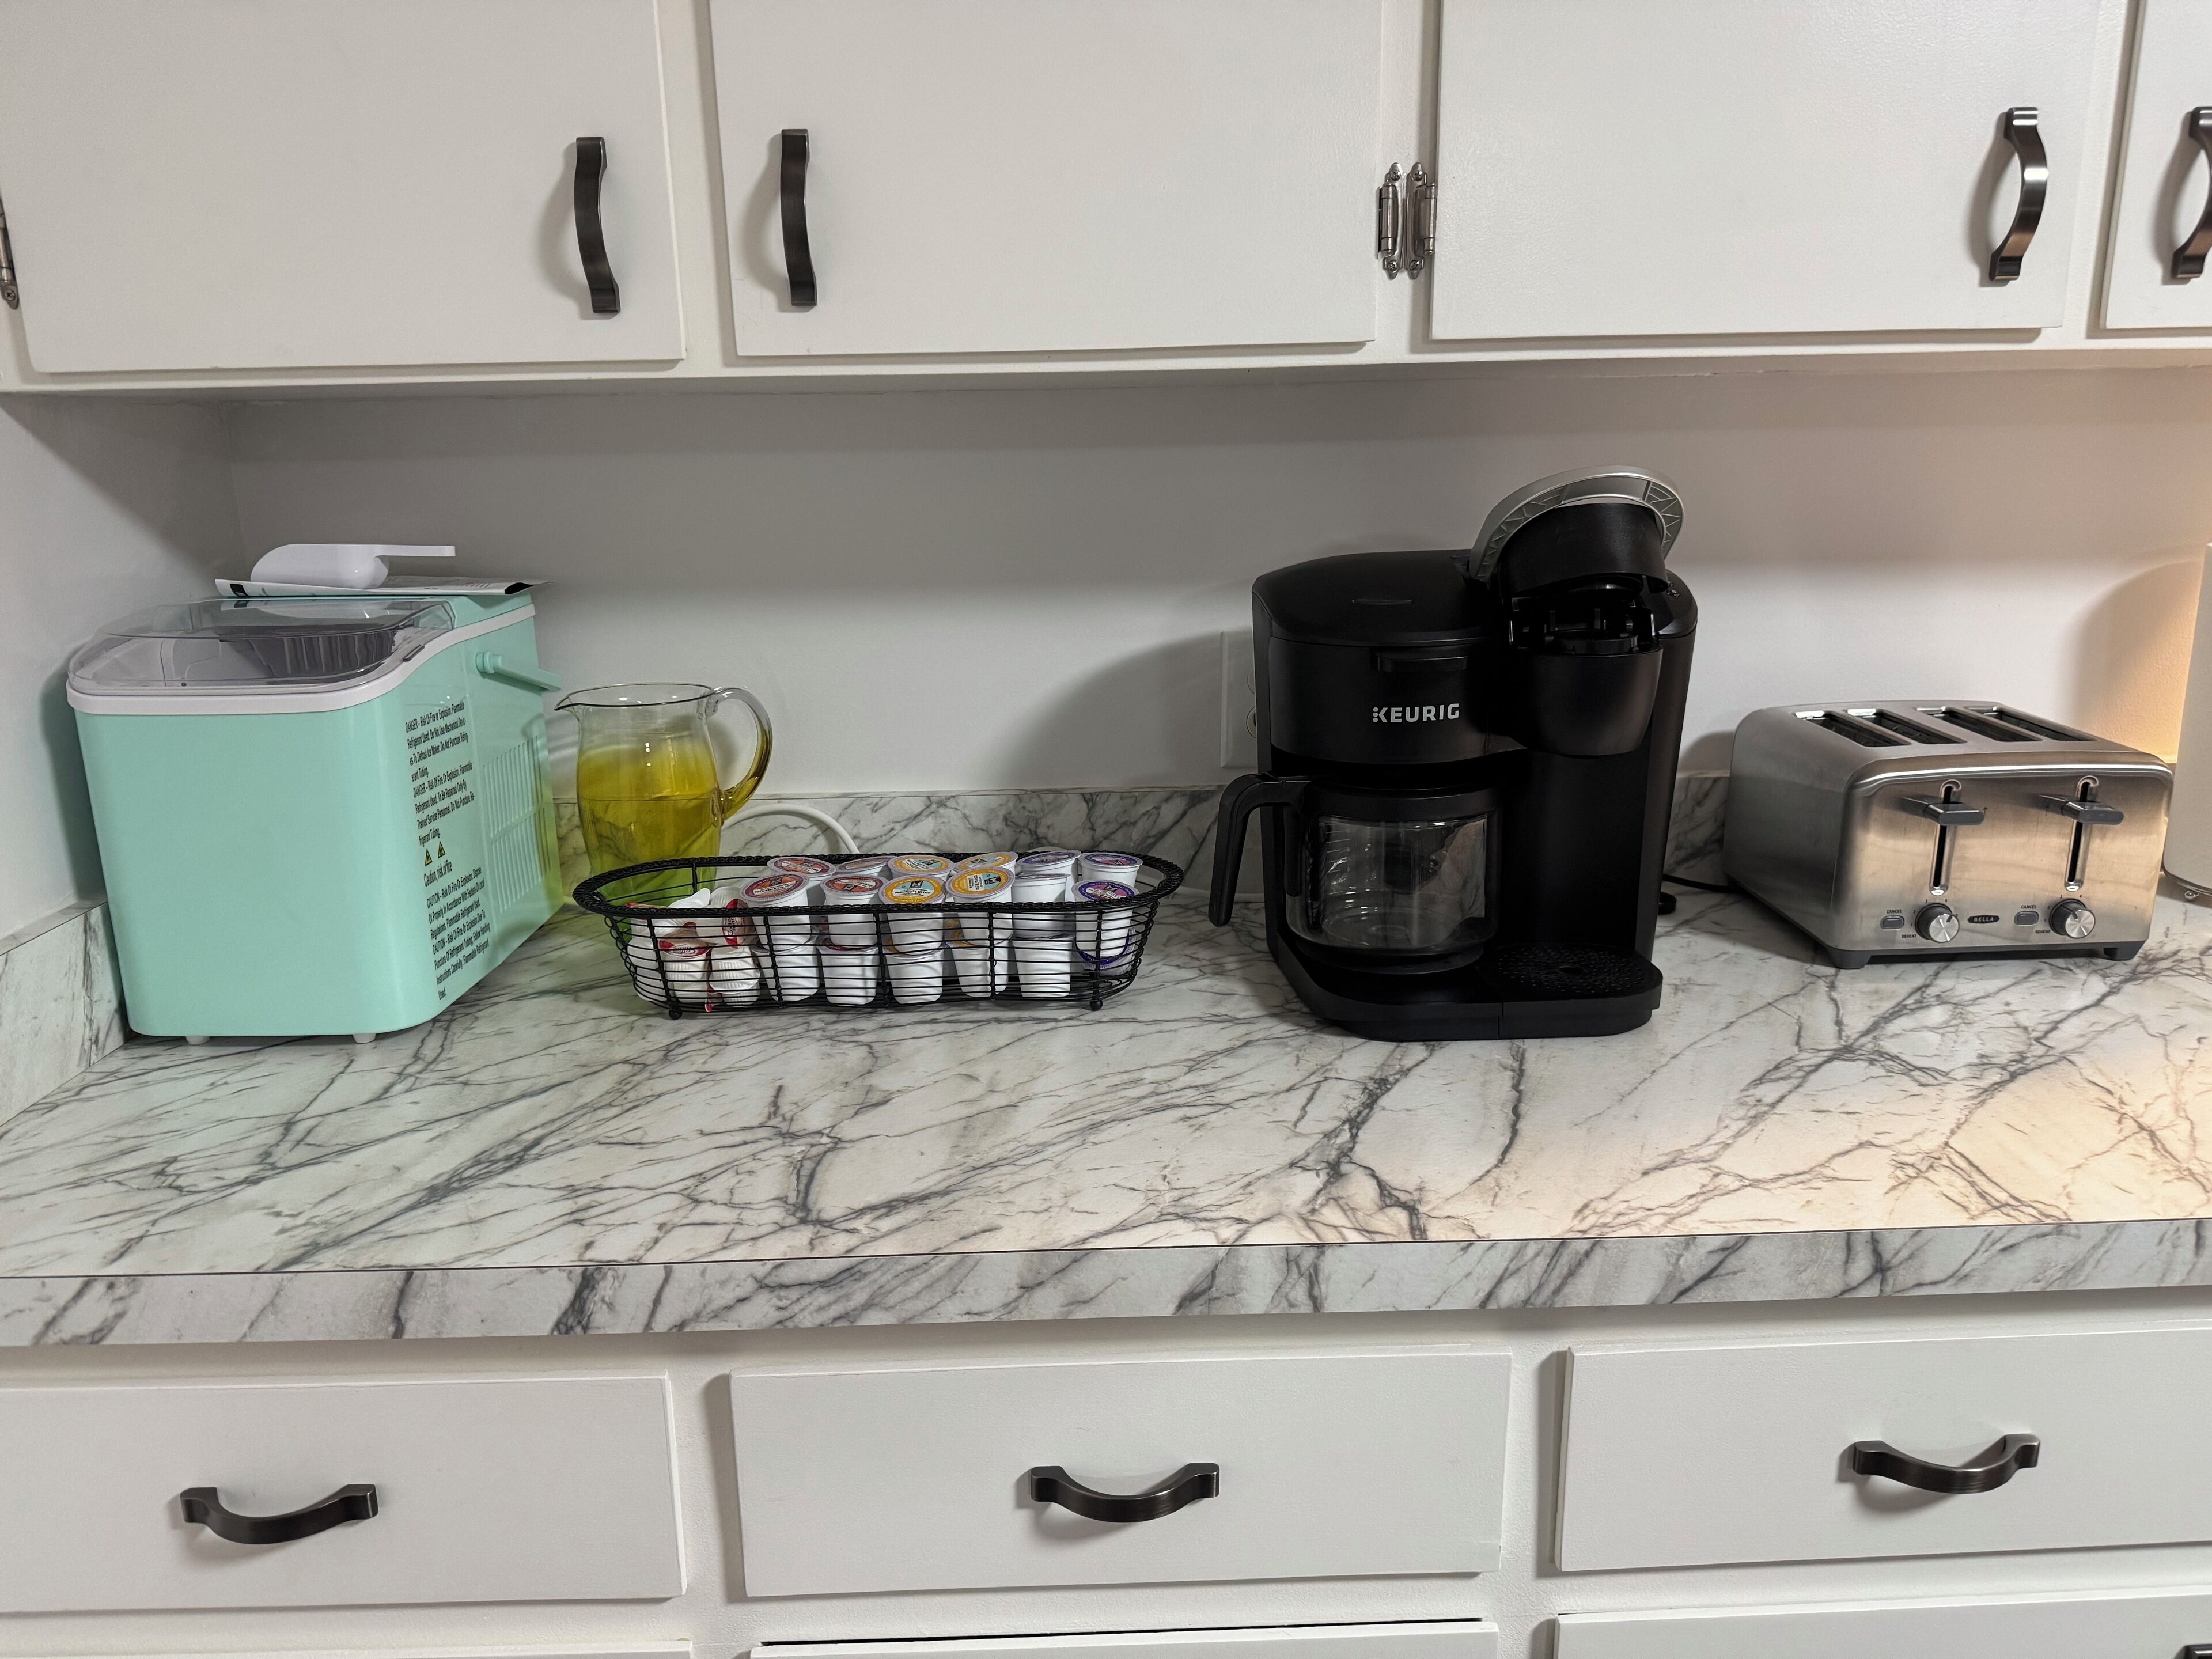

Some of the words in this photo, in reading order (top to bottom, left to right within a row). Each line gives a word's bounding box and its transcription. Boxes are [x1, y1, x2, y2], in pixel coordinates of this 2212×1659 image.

[405, 718, 418, 733] DANGER
[426, 713, 430, 724] Of
[1373, 703, 1459, 722] KEURIG
[407, 734, 423, 749] Refrigerant
[430, 729, 434, 739] Do
[409, 757, 414, 766] es
[416, 748, 427, 762] Defrost
[440, 741, 445, 752] Do
[449, 734, 461, 747] Puncture
[413, 782, 426, 798] DANGER
[434, 776, 438, 787] Of
[415, 797, 430, 815] Refrigerant
[441, 790, 446, 800] Be
[445, 783, 457, 800] Repaired
[462, 779, 467, 791] By
[416, 815, 428, 830] Trained
[427, 811, 438, 824] Service
[450, 801, 455, 812] Do
[459, 795, 471, 807] Puncture
[442, 862, 447, 875] of
[426, 892, 440, 908] CAUTION
[448, 883, 452, 895] Of
[429, 912, 433, 924] Of
[431, 906, 444, 922] Properly
[442, 904, 446, 914] In
[446, 896, 461, 912] Accordance
[460, 902, 474, 919] Refrigerant
[432, 937, 445, 955] CAUTION
[453, 928, 457, 940] Of
[434, 955, 446, 970] Puncture
[446, 950, 450, 961] Of
[449, 941, 464, 959] Refrigerant
[472, 930, 480, 942] Follow
[436, 968, 452, 986] Instructions
[476, 938, 490, 955] Refrigerant
